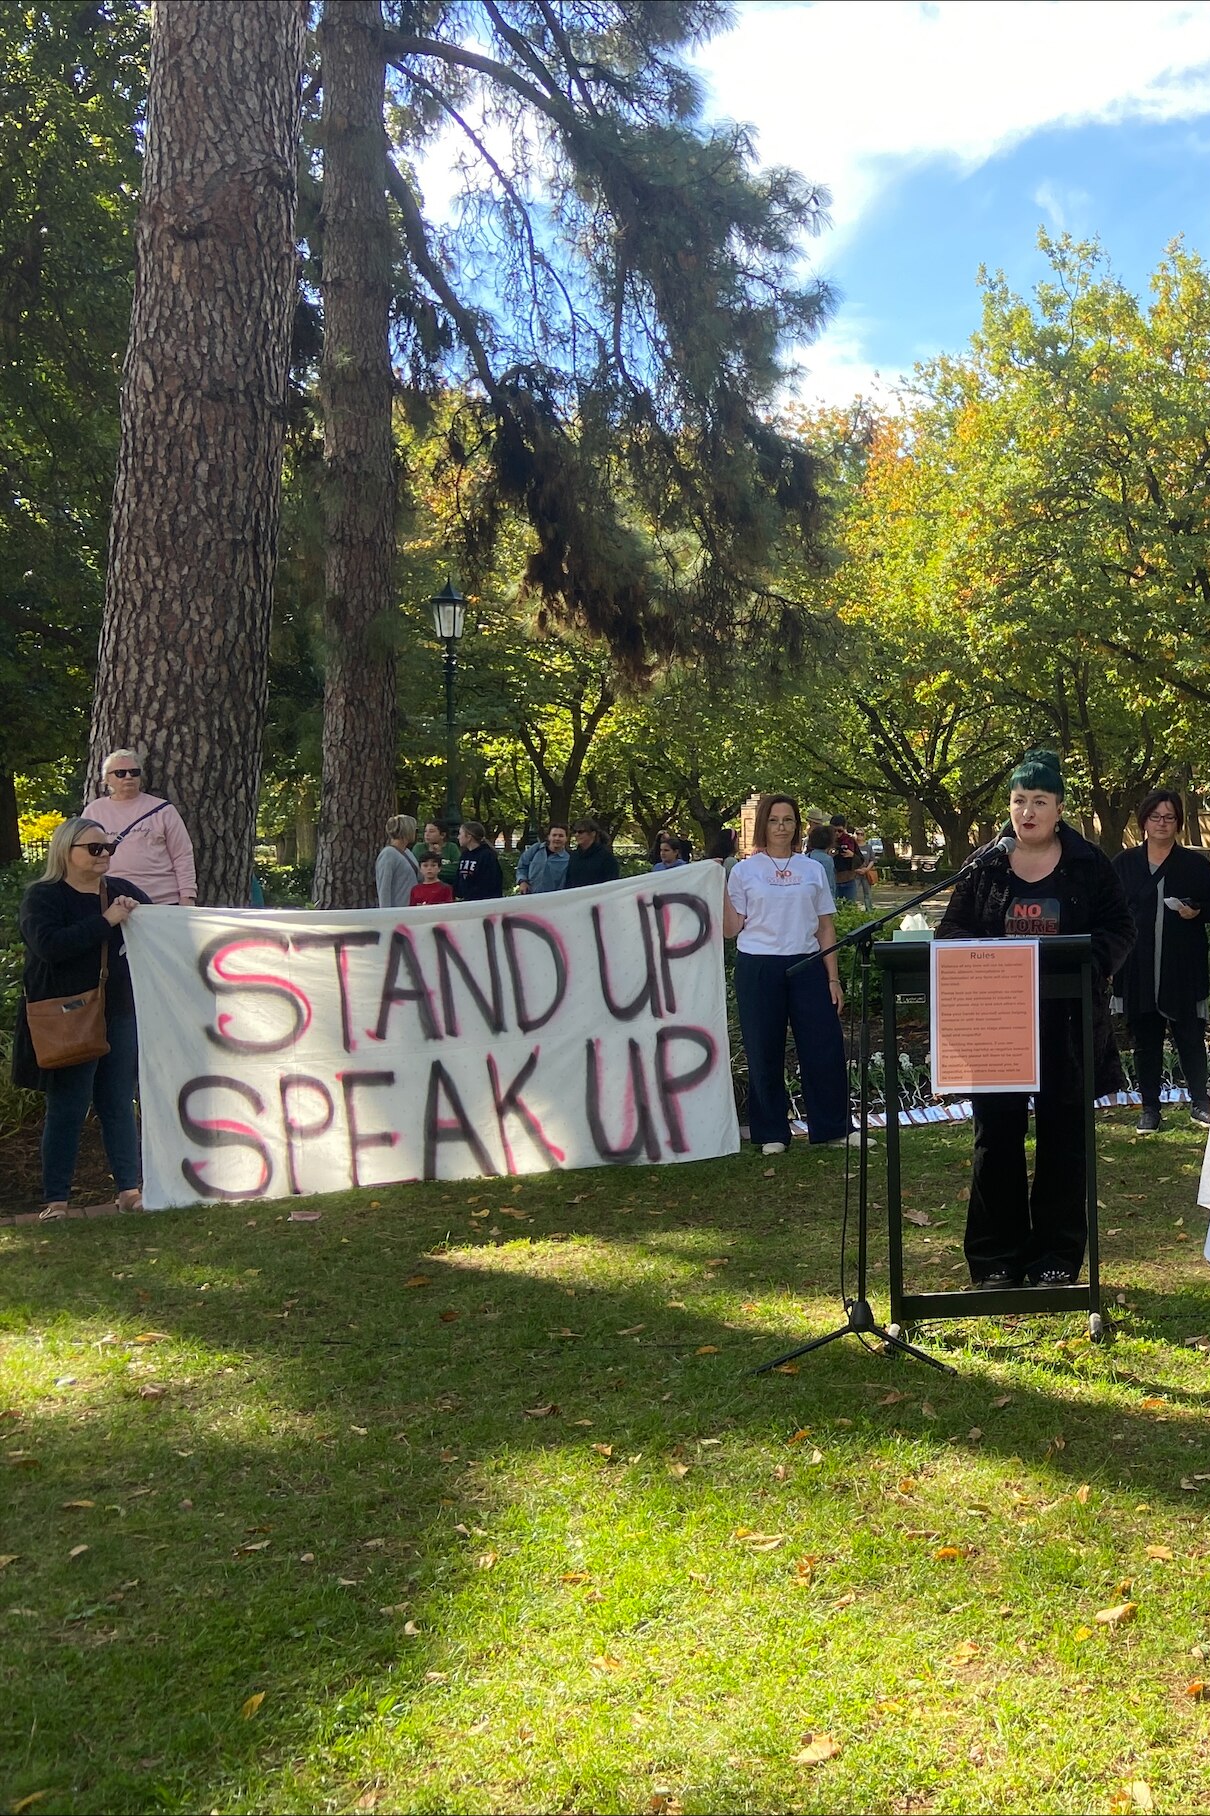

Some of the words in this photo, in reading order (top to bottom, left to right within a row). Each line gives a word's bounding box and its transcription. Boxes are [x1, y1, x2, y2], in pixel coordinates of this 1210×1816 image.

[775, 870, 792, 878] NO
[1013, 903, 1042, 918] NO
[970, 951, 996, 960] Rules
[198, 913, 569, 1056] STAND
[592, 892, 712, 1020] UP
[178, 1045, 565, 1198] SPEAK
[586, 1026, 717, 1162] UP
